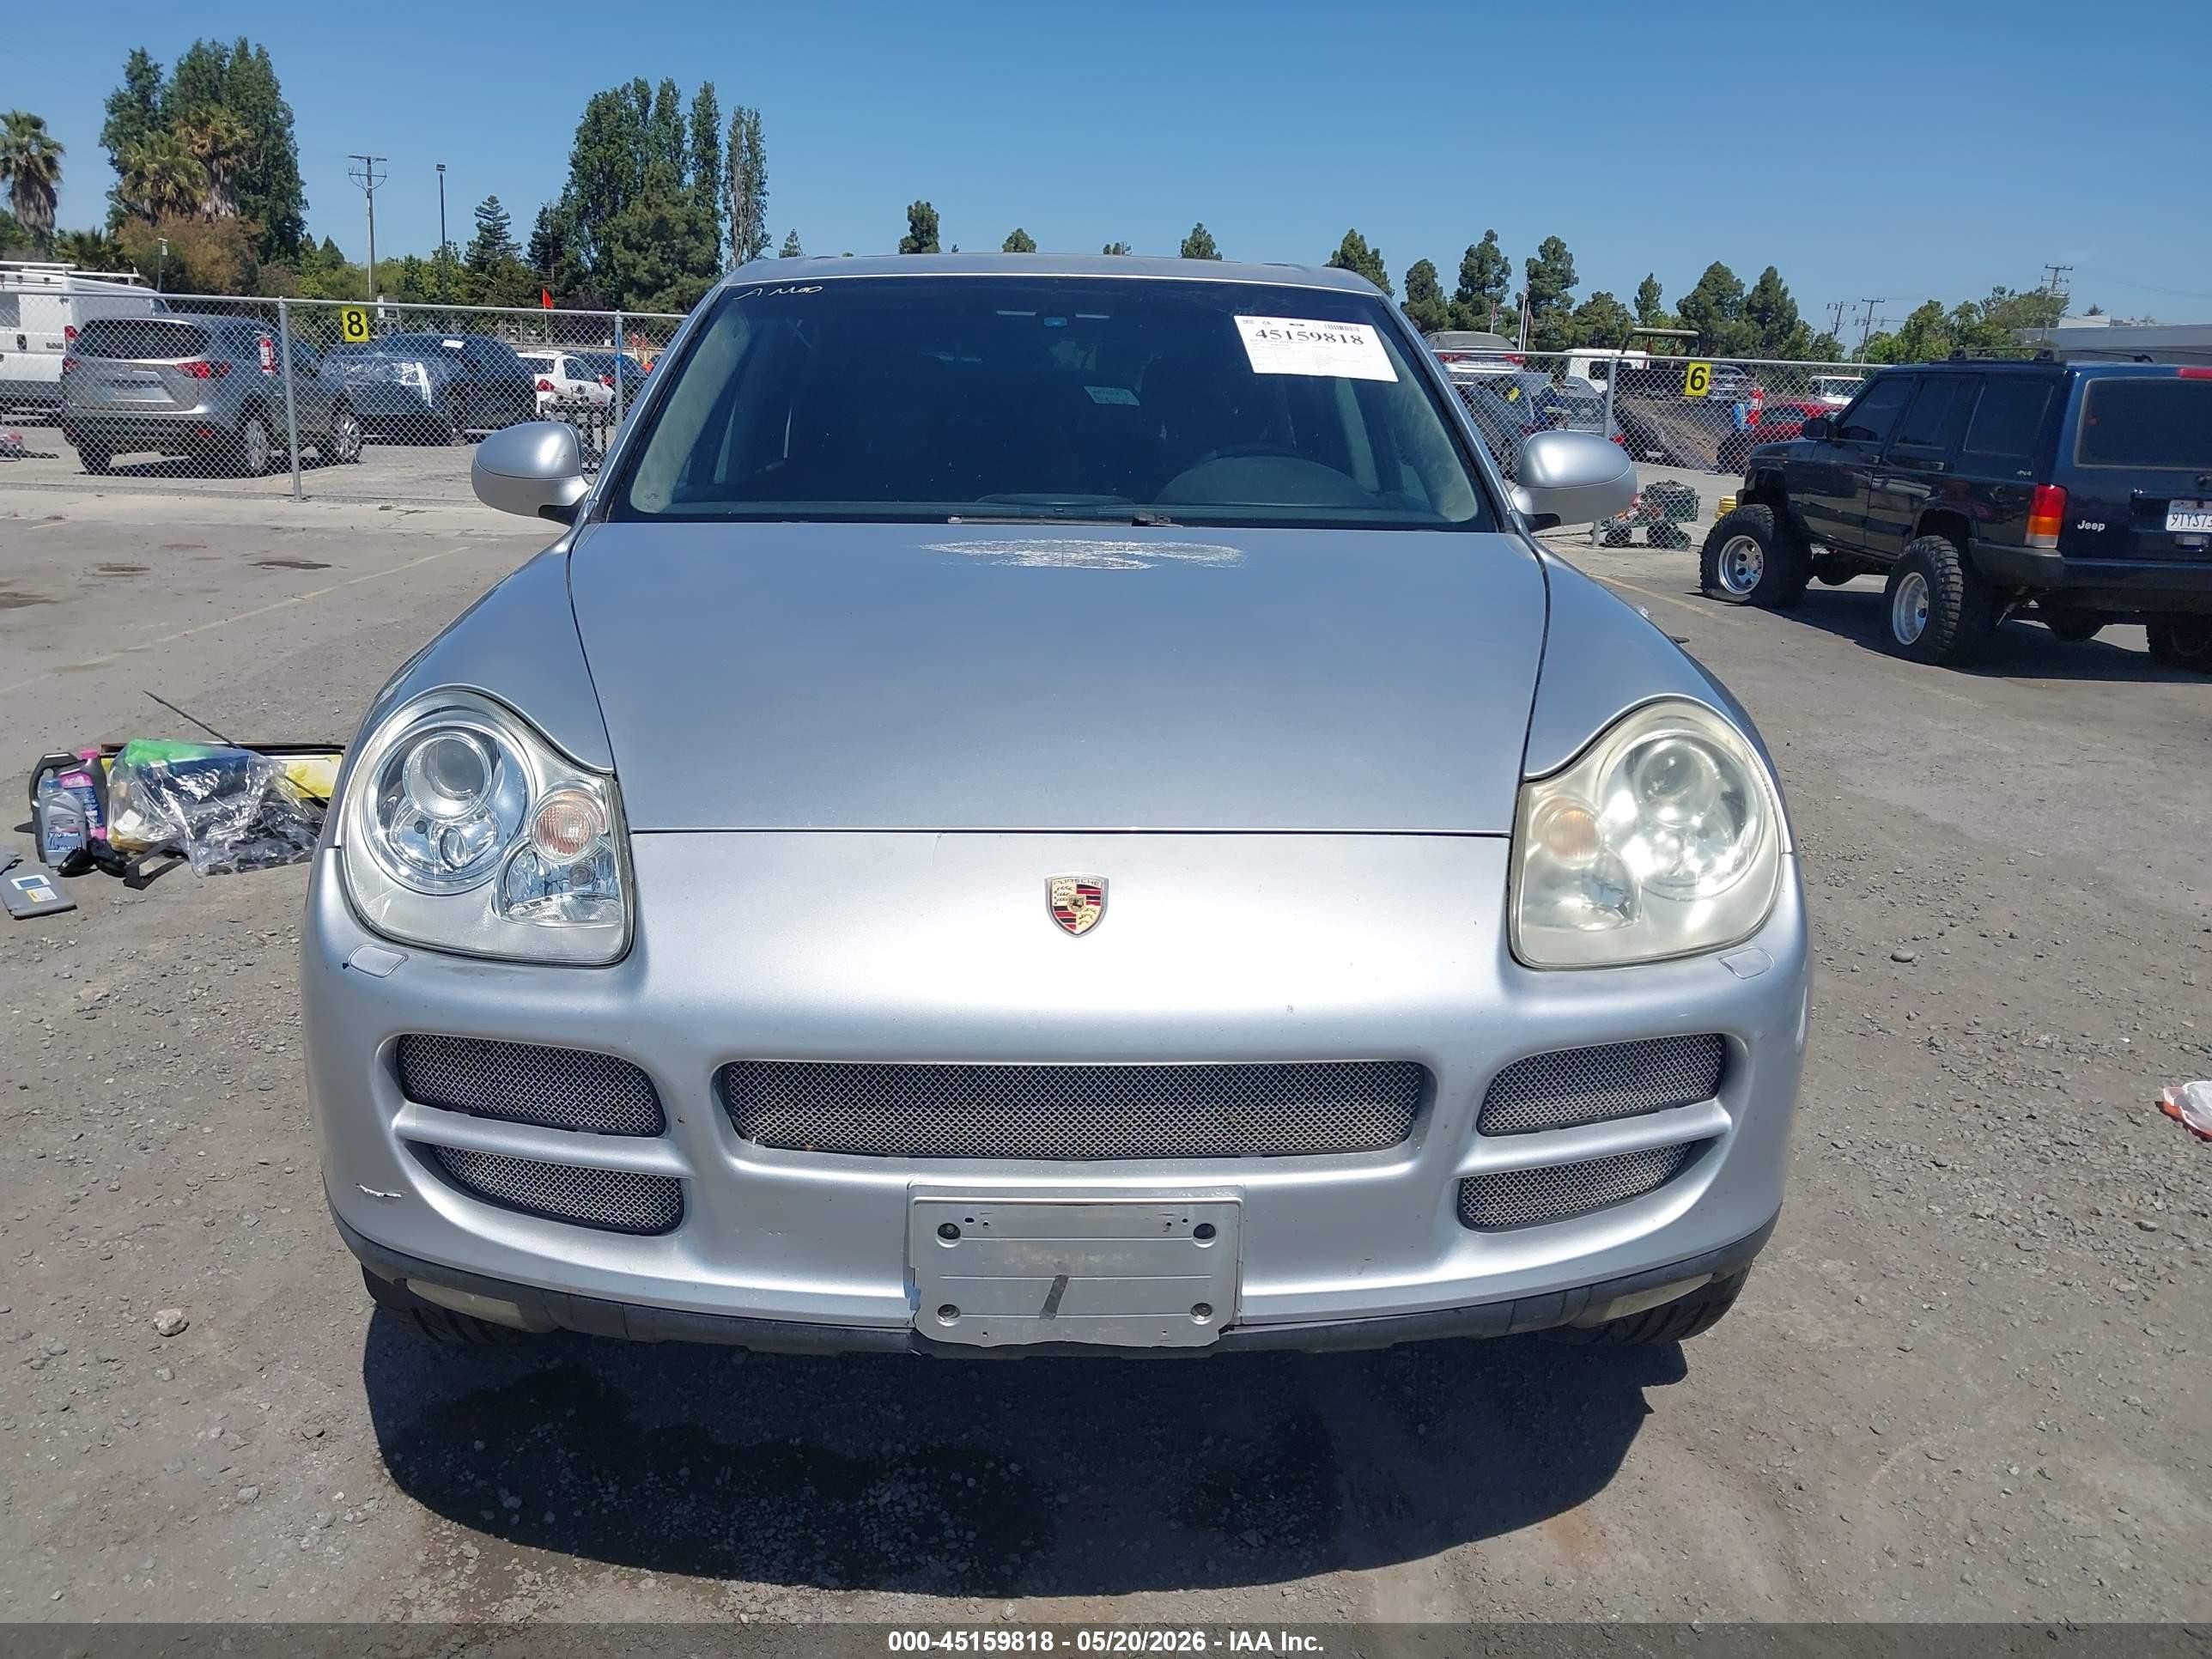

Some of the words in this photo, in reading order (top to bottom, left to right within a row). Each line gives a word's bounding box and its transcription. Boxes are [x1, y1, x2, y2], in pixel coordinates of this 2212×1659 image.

[346, 311, 364, 337] 8
[1255, 329, 1364, 345] 45159818
[1690, 367, 1706, 391] 6
[2077, 520, 2106, 532] Jeep
[1053, 878, 1100, 886] PORSCHE
